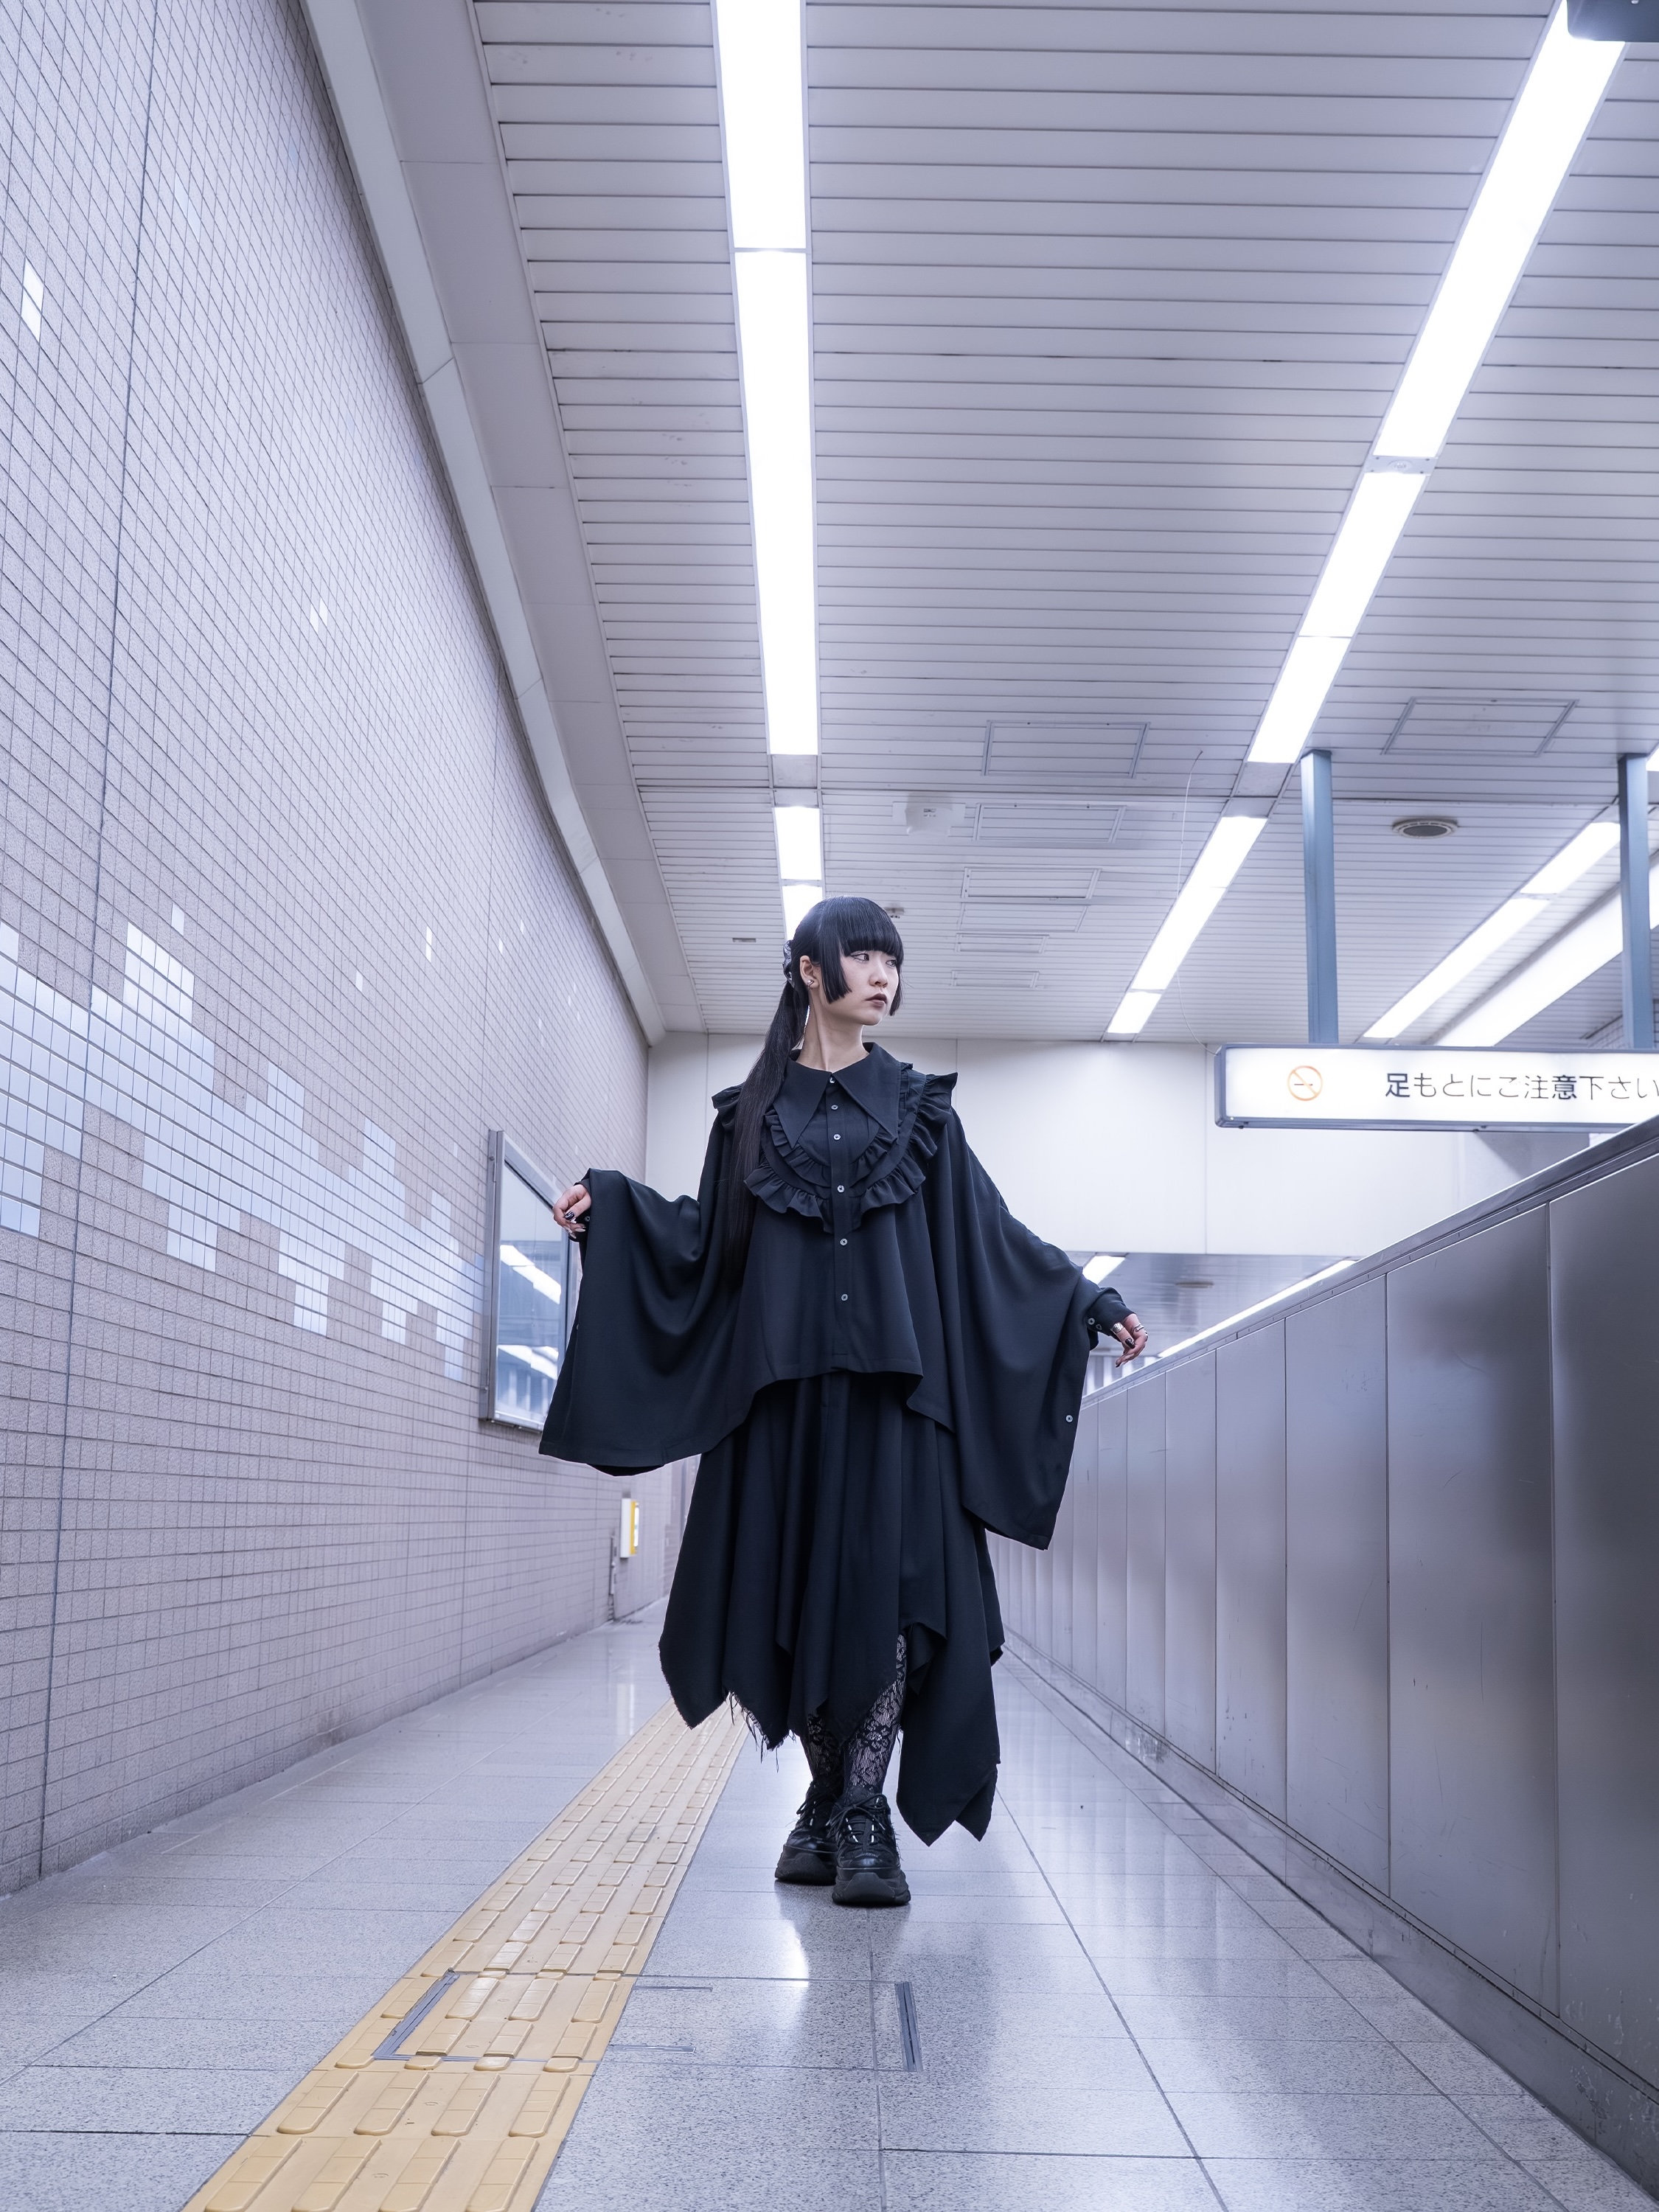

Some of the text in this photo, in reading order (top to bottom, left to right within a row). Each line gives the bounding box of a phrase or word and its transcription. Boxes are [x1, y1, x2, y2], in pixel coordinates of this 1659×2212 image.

[1385, 1072, 1659, 1100] 足もとにご注意下さい
